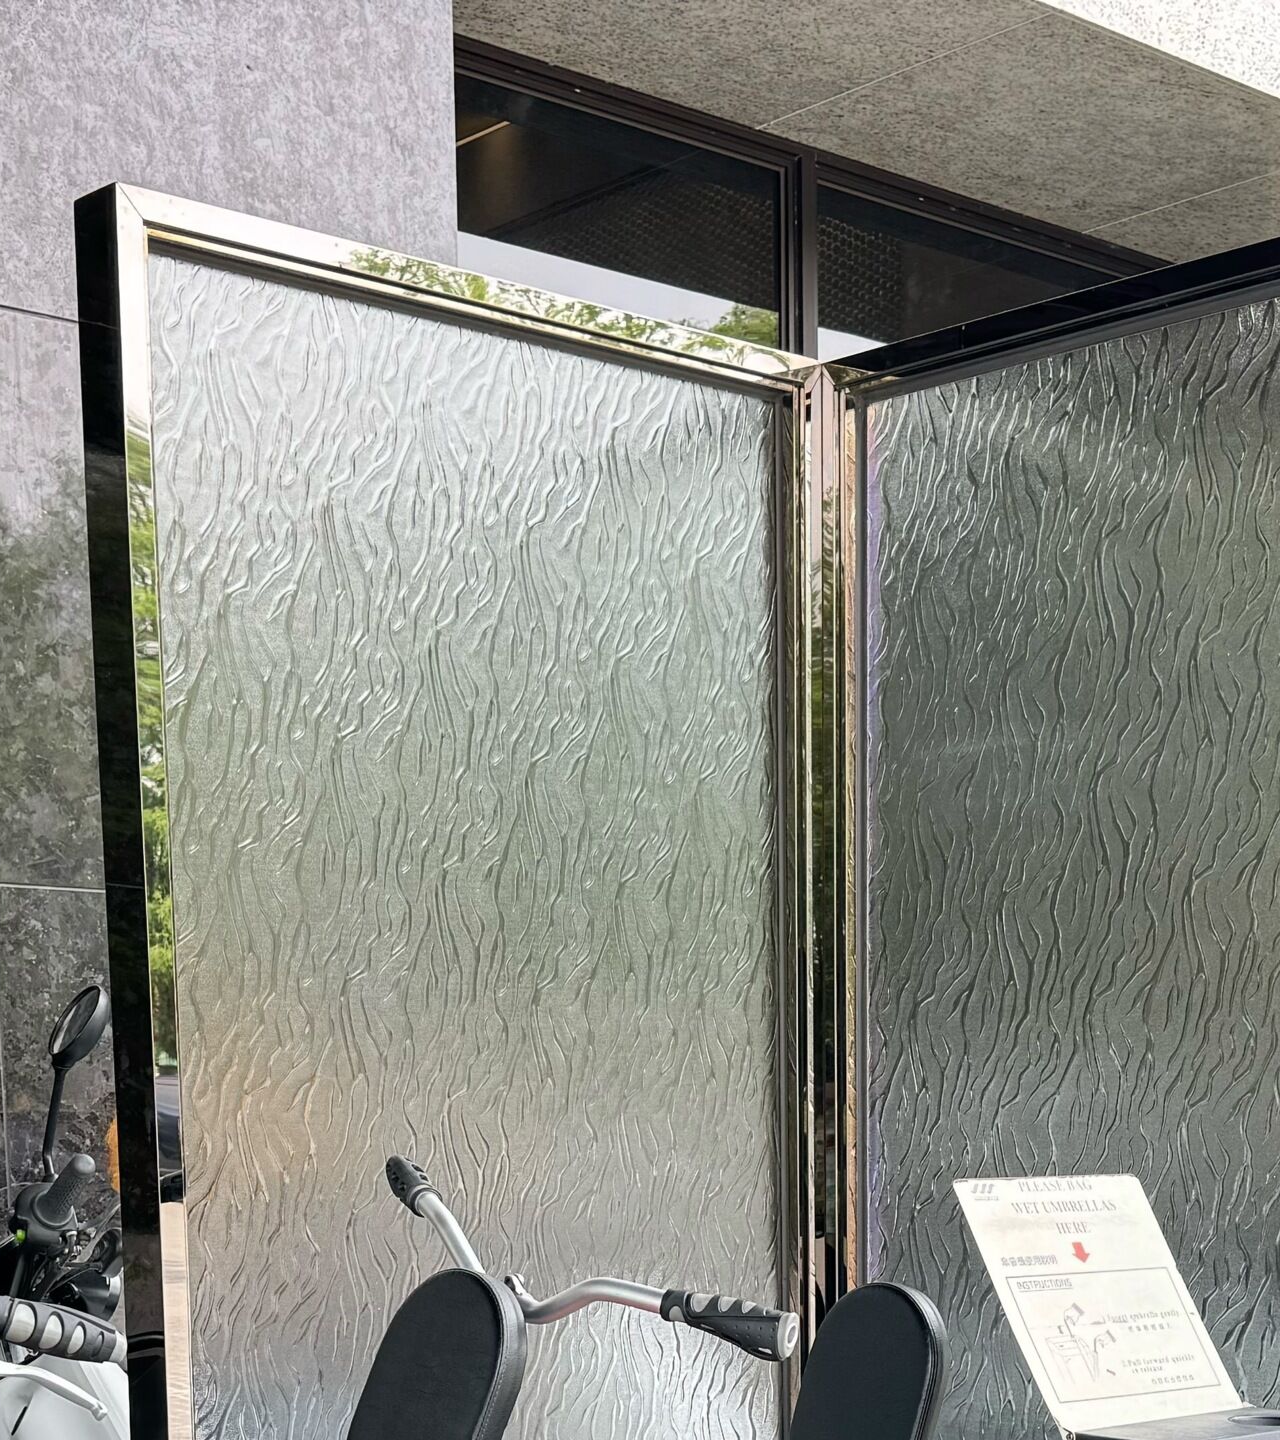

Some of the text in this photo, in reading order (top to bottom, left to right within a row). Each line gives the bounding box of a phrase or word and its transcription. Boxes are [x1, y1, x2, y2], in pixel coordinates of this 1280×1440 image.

[1018, 1179, 1092, 1192] PLEASE BAG
[1011, 1199, 1117, 1214] WET UMBRELLAS
[1055, 1221, 1091, 1234] HERE
